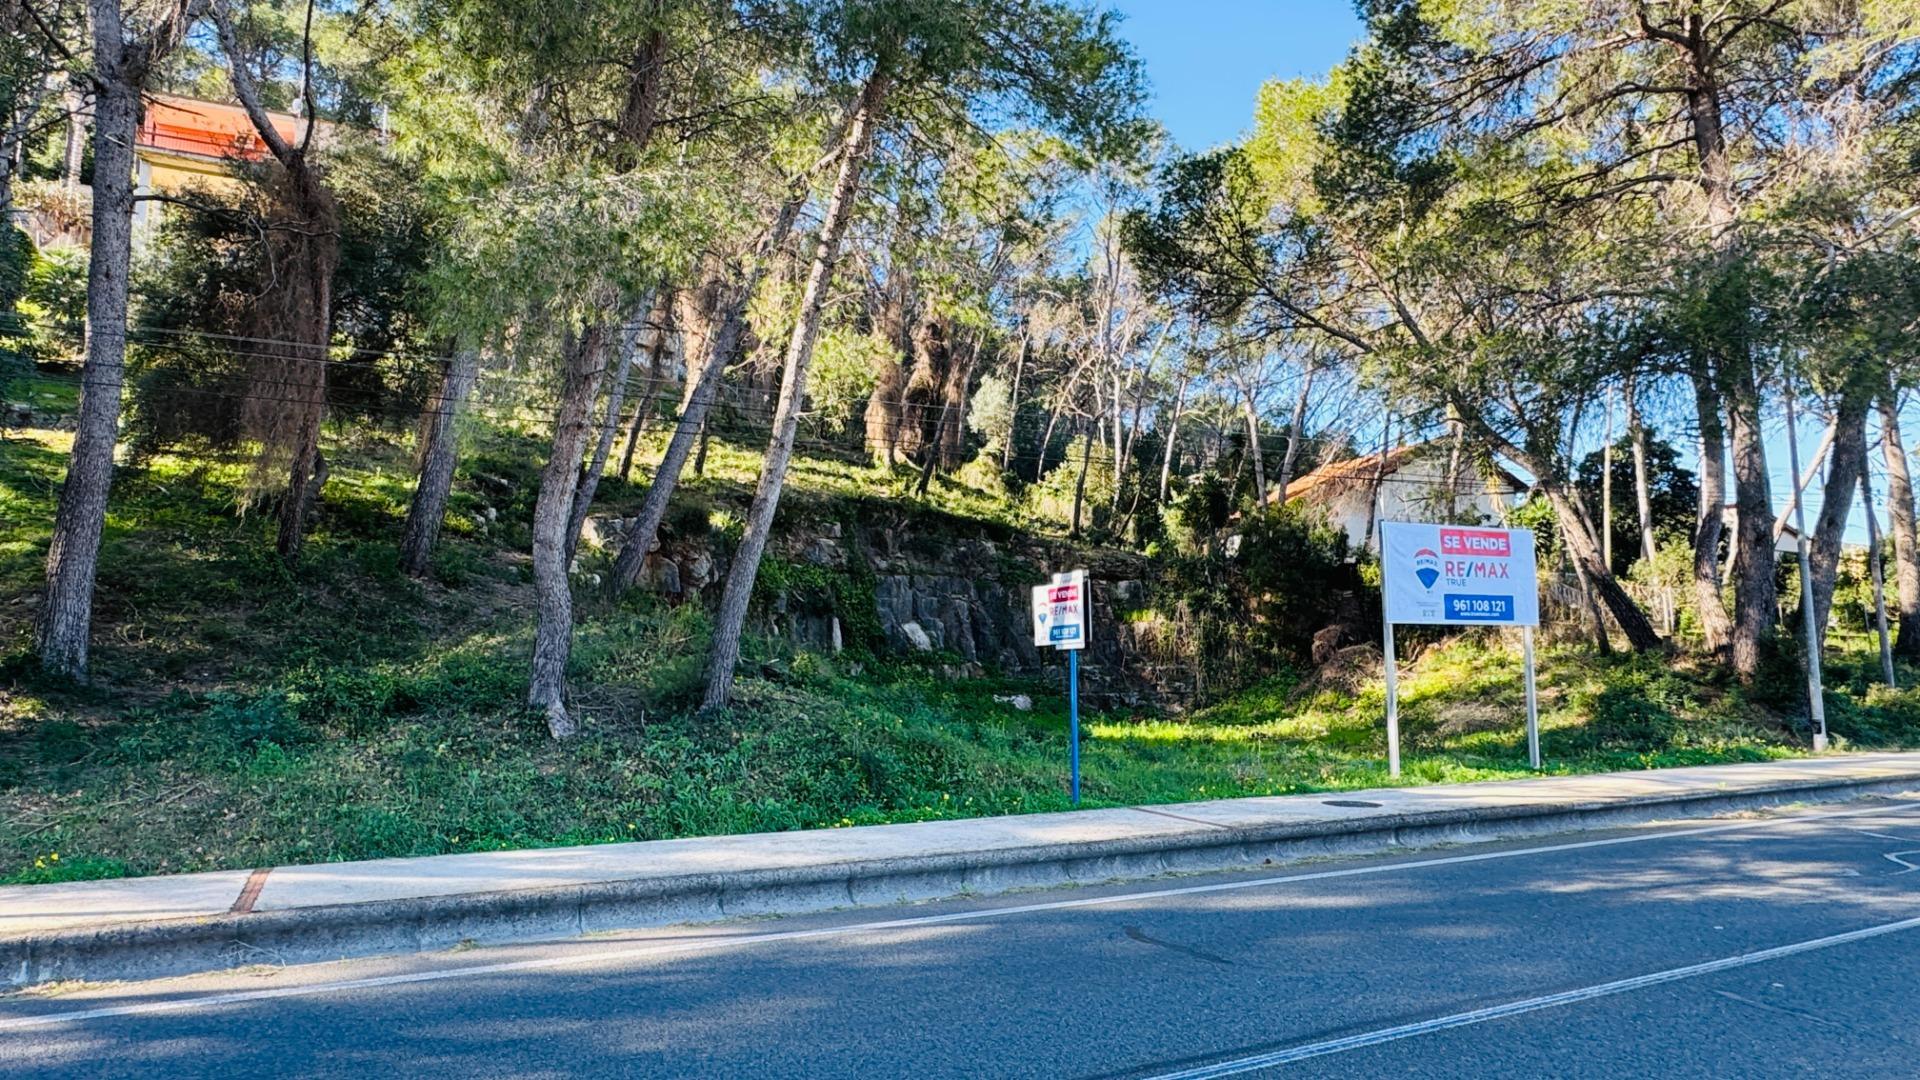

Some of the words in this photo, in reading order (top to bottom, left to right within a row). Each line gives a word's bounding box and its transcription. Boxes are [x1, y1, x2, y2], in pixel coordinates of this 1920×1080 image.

[1444, 536, 1460, 548] SE
[1464, 537, 1506, 550] VENDE
[1445, 561, 1509, 578] RE/MAX
[1446, 578, 1467, 587] TRUE
[1453, 599, 1471, 611] 961
[1472, 600, 1490, 612] 108
[1491, 600, 1506, 612] 121
